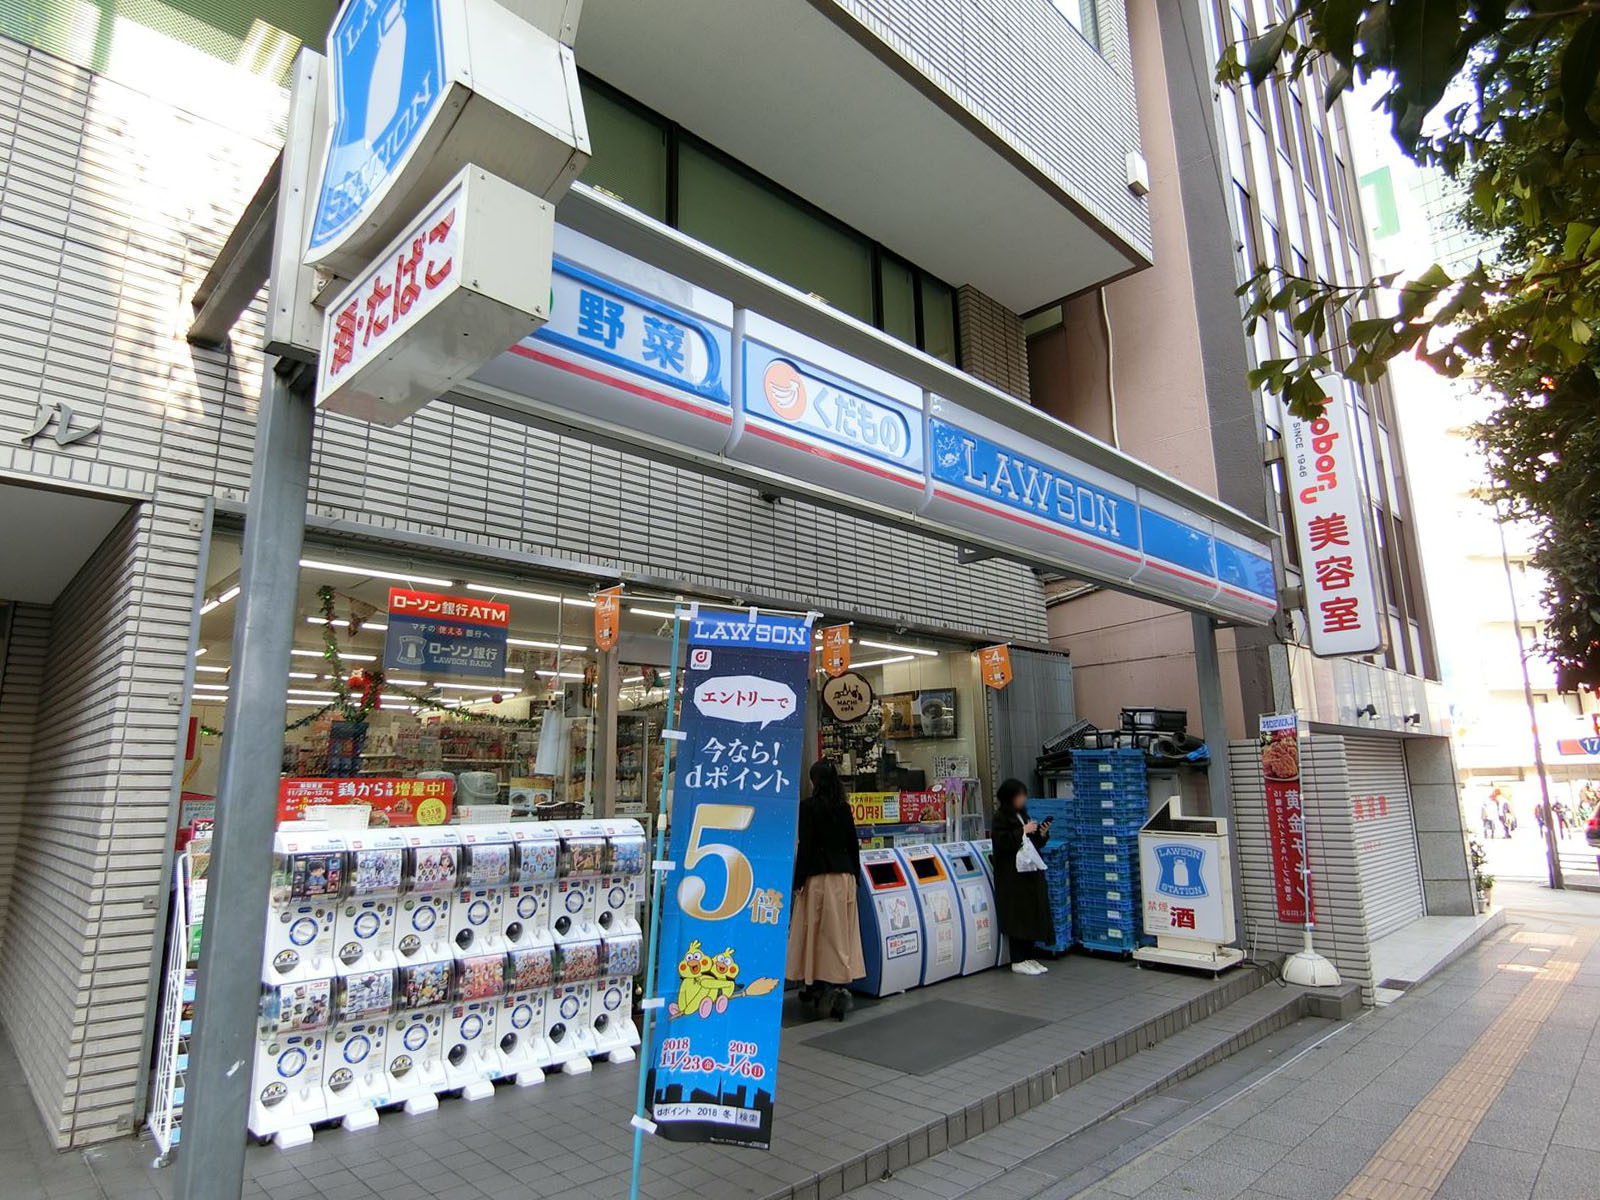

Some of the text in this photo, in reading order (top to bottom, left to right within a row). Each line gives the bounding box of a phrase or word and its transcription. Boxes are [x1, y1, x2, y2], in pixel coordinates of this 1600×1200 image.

[577, 289, 686, 374] 野菜
[812, 387, 900, 452] くだもの
[1297, 454, 1308, 478] 1946
[962, 438, 1121, 538] LAWSON
[1308, 512, 1361, 634] 美容室
[393, 595, 506, 622] ローソン銀行ATM
[694, 621, 807, 645] LAWSON
[429, 642, 498, 660] ローソン銀行
[701, 690, 789, 709] エントリーで
[701, 737, 781, 766] 今なら!
[685, 763, 790, 793] dポイント
[1158, 847, 1201, 860] LAWSON
[1161, 883, 1204, 895] STATION
[1170, 906, 1196, 930] 酒
[663, 1038, 689, 1051] 2018
[729, 1041, 757, 1055] 2019
